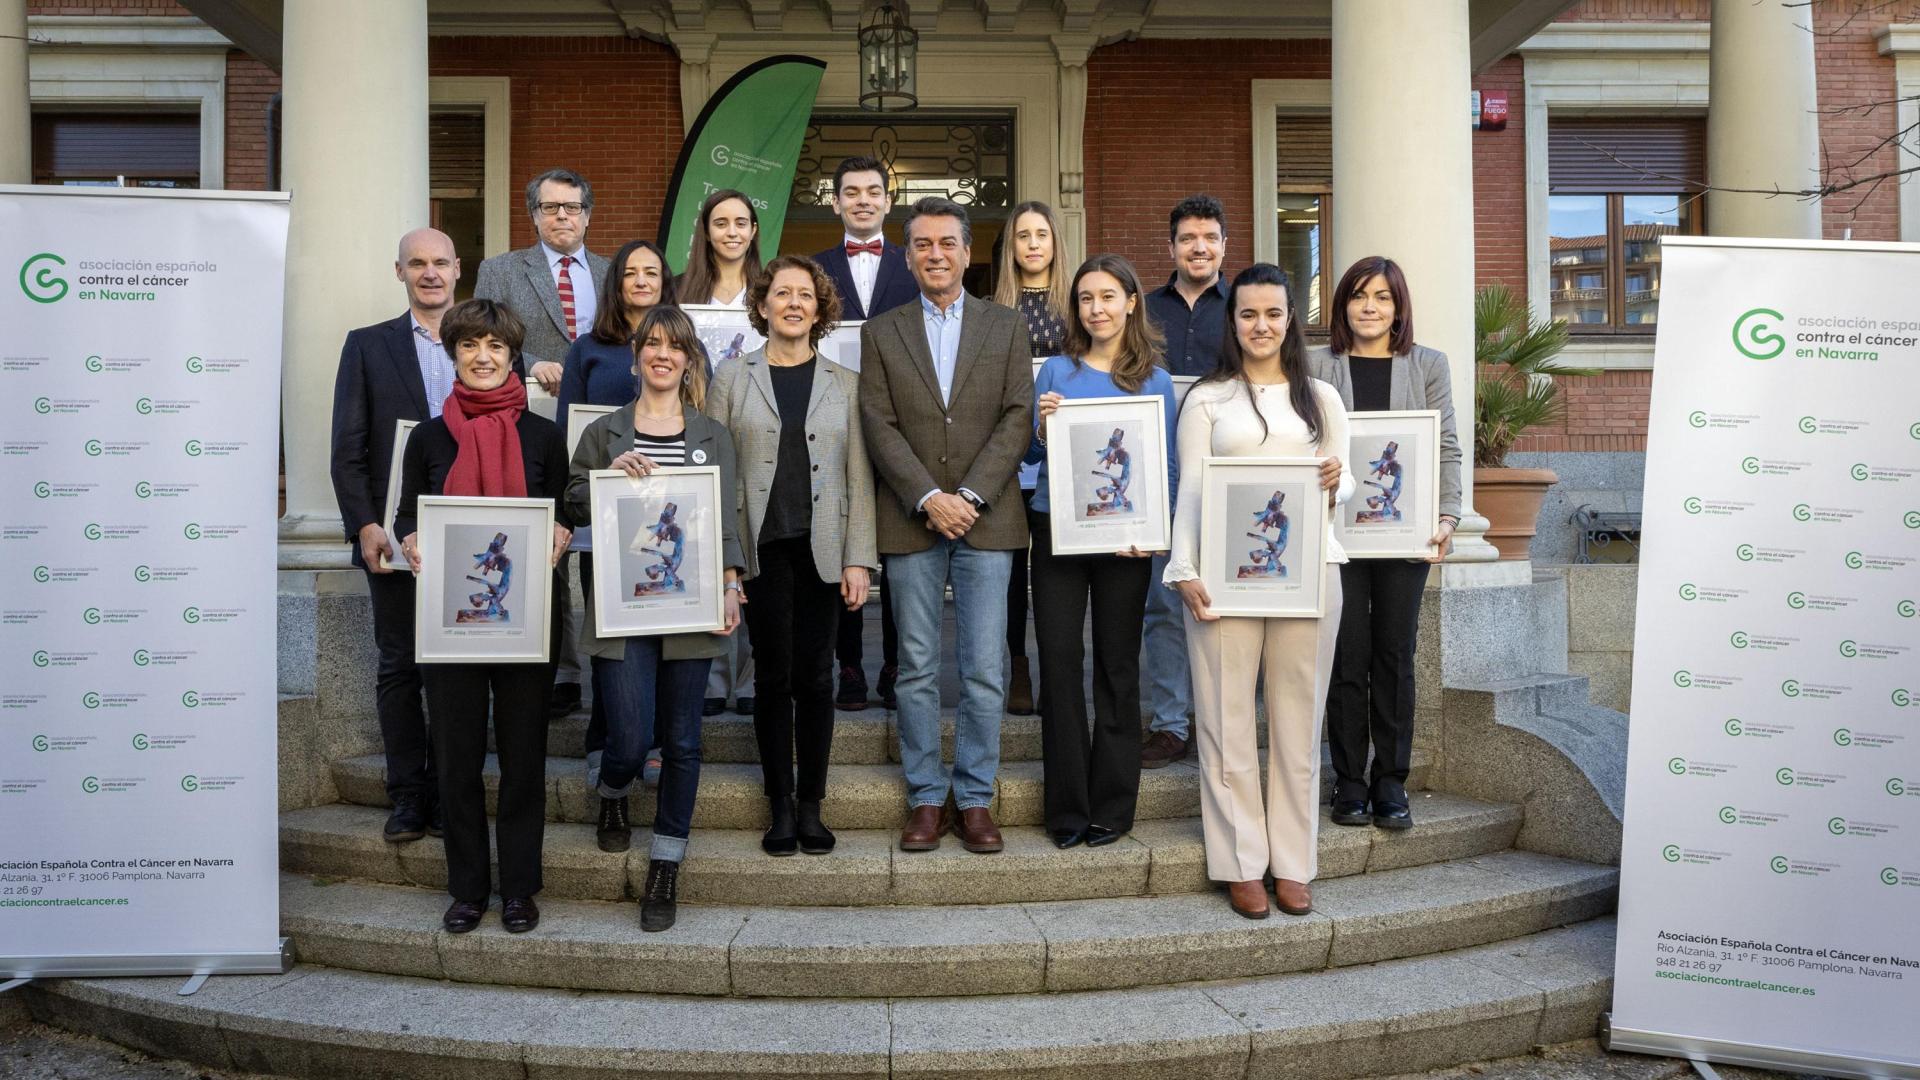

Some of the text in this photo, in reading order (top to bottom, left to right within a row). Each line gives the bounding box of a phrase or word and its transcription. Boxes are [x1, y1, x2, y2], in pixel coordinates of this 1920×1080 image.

[80, 259, 217, 274] asociación española
[79, 274, 189, 286] contra el cáncer
[79, 289, 155, 301] en Navarra
[1797, 316, 1877, 330] asociación
[1796, 332, 1918, 347] contra el cáncer
[1795, 347, 1879, 361] en Navarra
[0, 861, 38, 870] ciación
[41, 860, 88, 871] Española
[91, 860, 125, 868] Contra
[128, 859, 137, 867] el
[140, 858, 176, 868] Cáncer
[193, 858, 234, 866] Navarra
[79, 872, 110, 882] 31006
[166, 871, 205, 880] Navarra
[3, 886, 44, 896] 21 26 97
[1658, 930, 1718, 945] Asociación
[1720, 937, 1772, 951] Española
[1775, 944, 1813, 956] Contra
[1816, 948, 1827, 958] el
[1830, 950, 1870, 962] Cáncer
[1873, 956, 1887, 965] en
[1656, 957, 1722, 973] 948 21 26 97
[1762, 956, 1795, 967] 31006
[1859, 966, 1902, 980] Navarra
[1655, 970, 1816, 995] asociacioncontraelcancer.es
